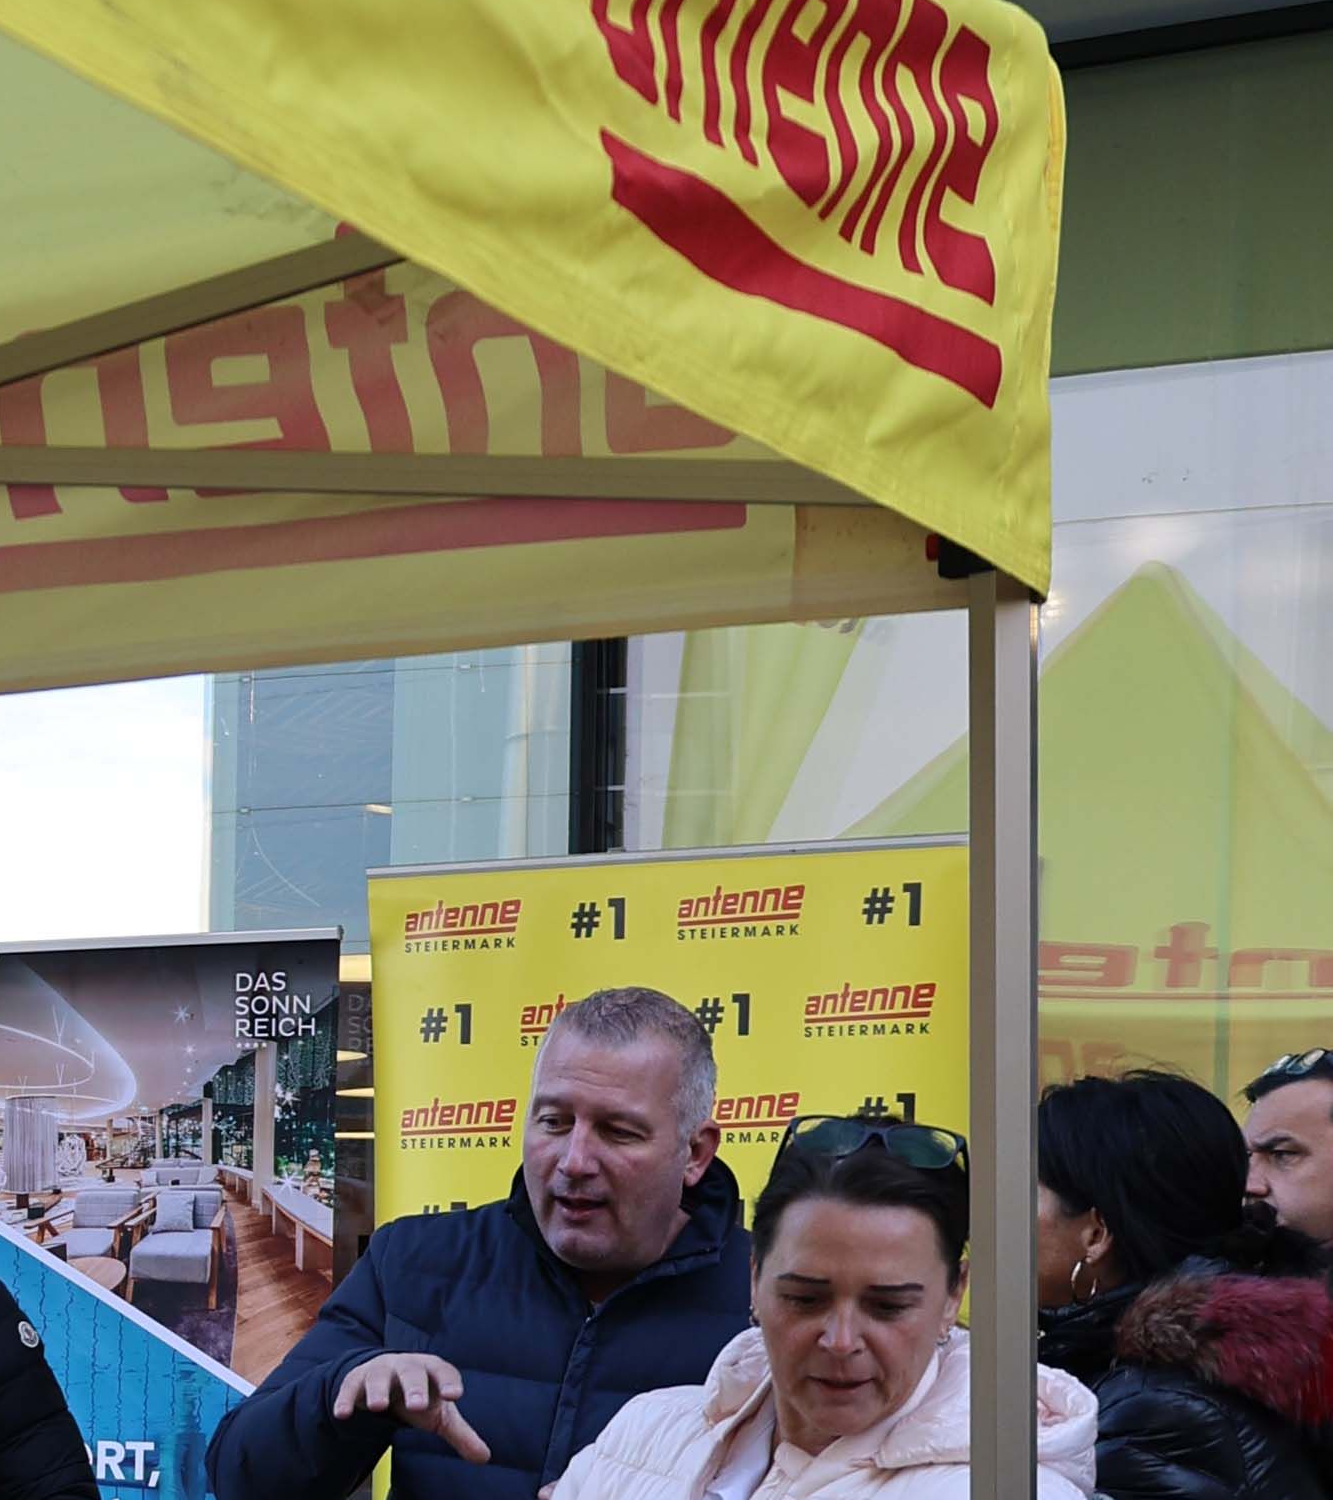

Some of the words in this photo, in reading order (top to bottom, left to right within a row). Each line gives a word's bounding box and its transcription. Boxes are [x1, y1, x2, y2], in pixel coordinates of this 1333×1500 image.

[404, 899, 521, 932] antenne
[677, 884, 805, 919] antenne
[862, 882, 923, 926] #1
[570, 897, 626, 940] #1
[678, 923, 800, 941] STEIERMARK
[404, 936, 516, 953] STEIERMARK
[235, 971, 287, 992] DAS
[235, 994, 311, 1016] SONN
[694, 993, 750, 1037] #1
[804, 982, 937, 1017] antenne
[235, 1017, 316, 1038] REICH
[420, 1003, 472, 1045] #1
[803, 1021, 931, 1038] STEIERMARK
[401, 1097, 517, 1129] antenne
[714, 1092, 801, 1121] enne
[400, 1135, 512, 1150] STEIERMARK
[85, 1440, 161, 1488] RT,
